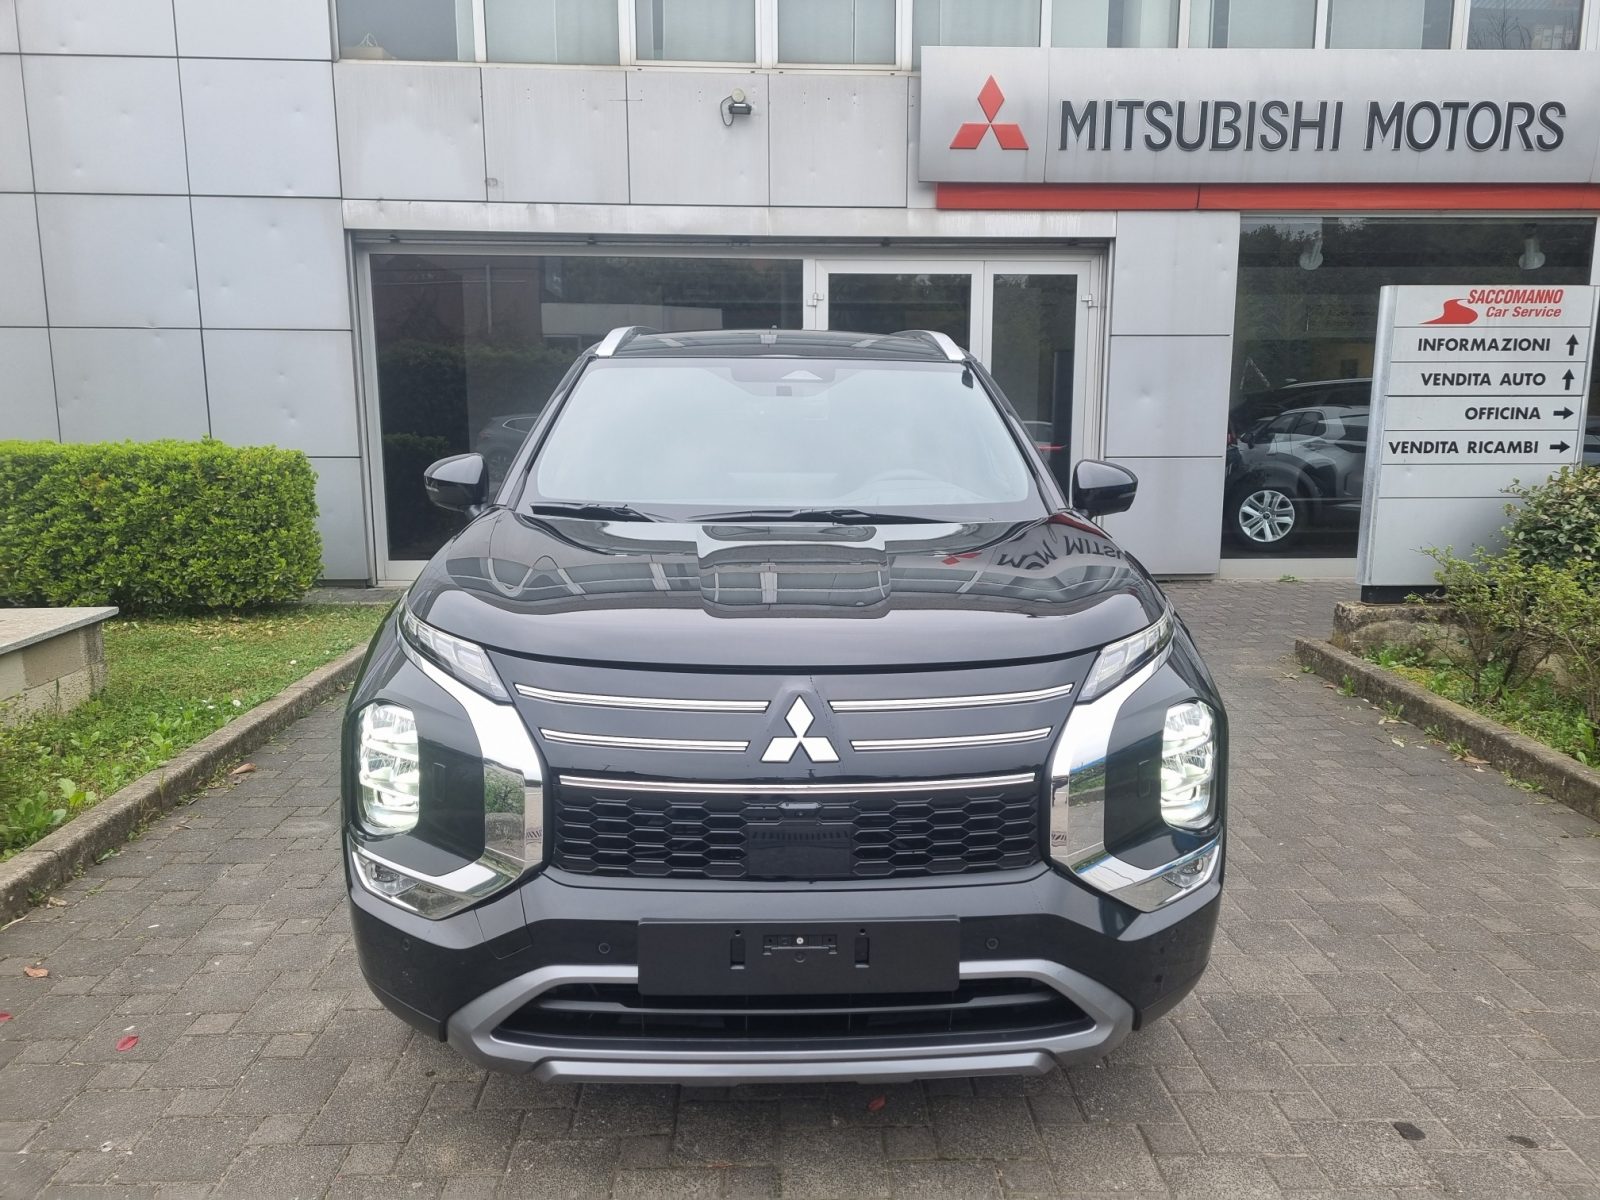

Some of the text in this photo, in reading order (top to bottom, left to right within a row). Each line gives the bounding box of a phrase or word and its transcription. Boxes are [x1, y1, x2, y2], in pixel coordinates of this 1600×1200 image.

[1058, 100, 1566, 153] MITSUBISHI MOTORS
[1468, 289, 1564, 304] SACCOMANNO
[1486, 305, 1562, 318] Car Service
[1417, 337, 1551, 352] INFORMAZIONI
[1420, 372, 1547, 386] VENDITA AUTO
[1464, 406, 1541, 421] OFFICINA
[1388, 440, 1539, 455] VENDITA RICAMBI
